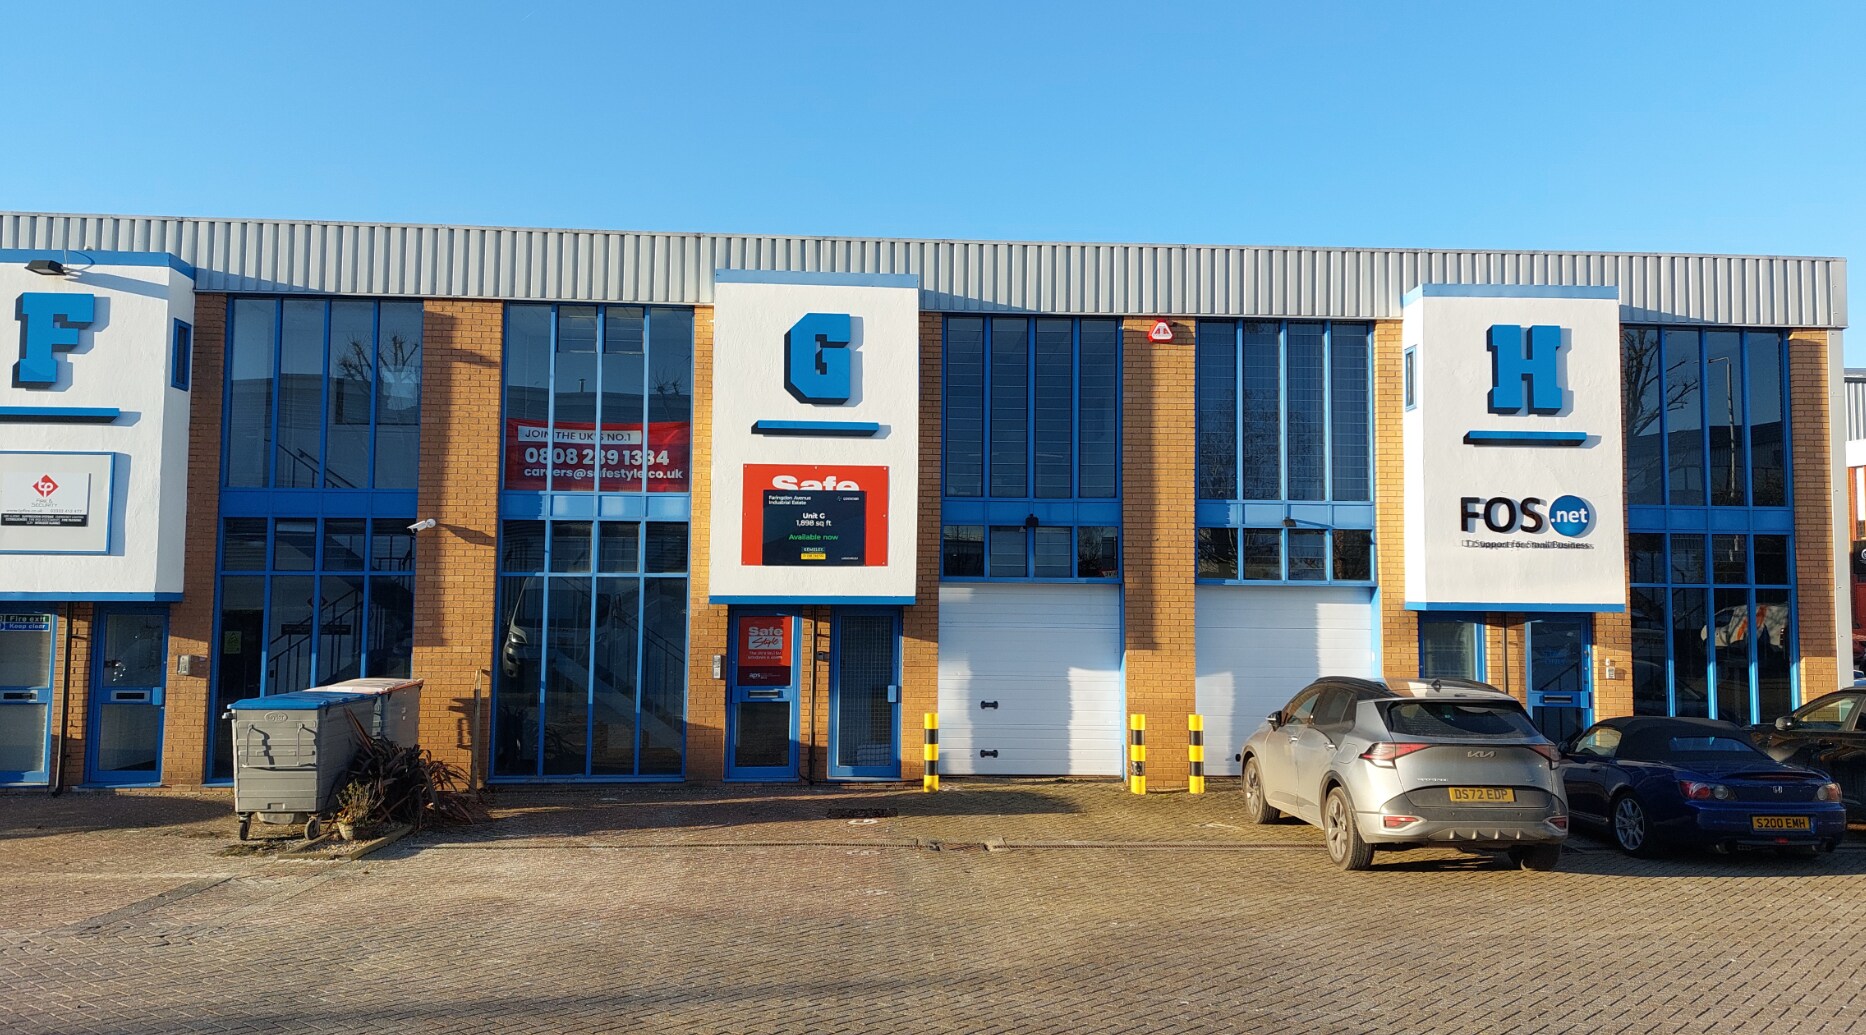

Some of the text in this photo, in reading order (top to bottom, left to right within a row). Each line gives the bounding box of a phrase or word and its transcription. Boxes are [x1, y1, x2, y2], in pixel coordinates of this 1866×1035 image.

[12, 292, 95, 388] F
[784, 313, 852, 405] G
[1487, 324, 1561, 415] H
[525, 429, 631, 442] JOIN THE UKS NO.1
[524, 447, 578, 465] 0808
[524, 467, 683, 481] carers@sfestyleco.uk
[788, 533, 821, 541] Available
[748, 626, 783, 636] Safe
[752, 637, 779, 648] Style
[1454, 788, 1508, 800] DS72 EDP
[1756, 817, 1806, 828] S200 EMH
